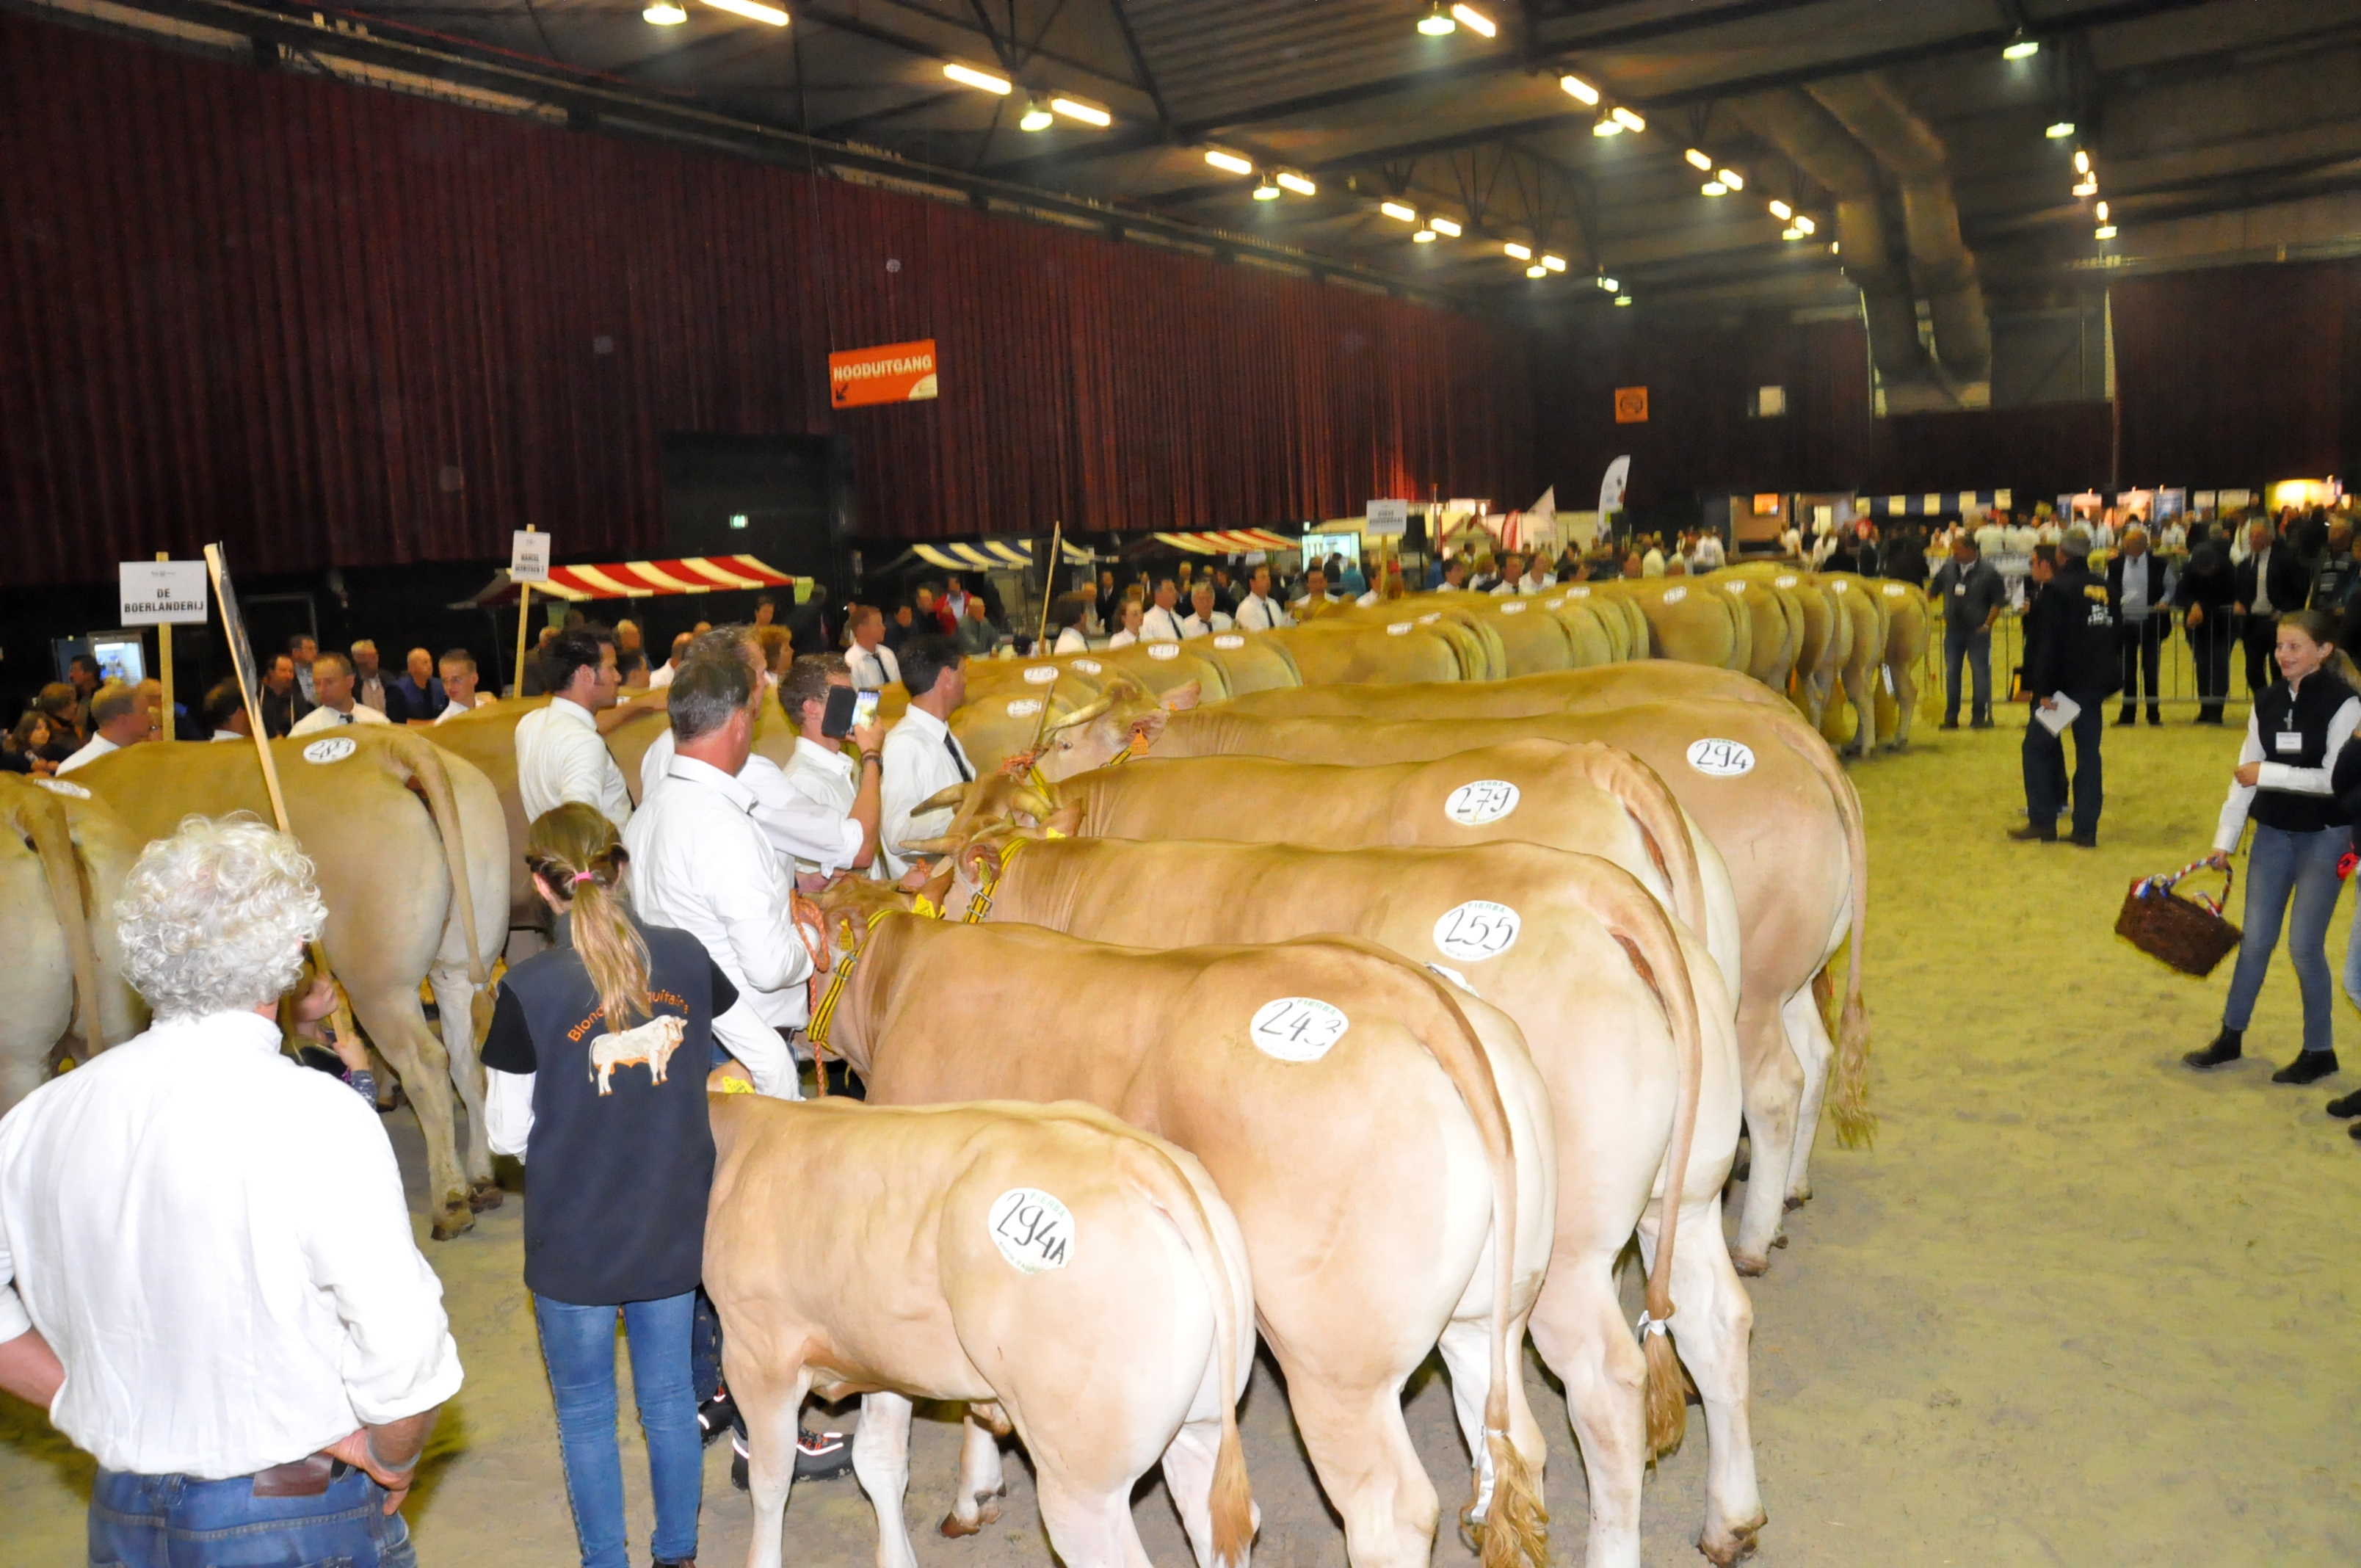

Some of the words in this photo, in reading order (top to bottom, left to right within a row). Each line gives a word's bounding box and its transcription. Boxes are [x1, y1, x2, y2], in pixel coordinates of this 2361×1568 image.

[833, 354, 933, 382] NOODUITGANG
[124, 600, 204, 613] BOERLANDERIJ
[156, 588, 170, 598] DE
[1696, 741, 1749, 769] 294
[1456, 787, 1512, 813] 279
[1468, 902, 1506, 914] FIERBA
[1445, 908, 1514, 951] 255
[1296, 998, 1337, 1016] FIERBA
[1258, 1001, 1341, 1046] 243
[1029, 1192, 1066, 1219] FIERBA
[996, 1192, 1067, 1265] 294A
